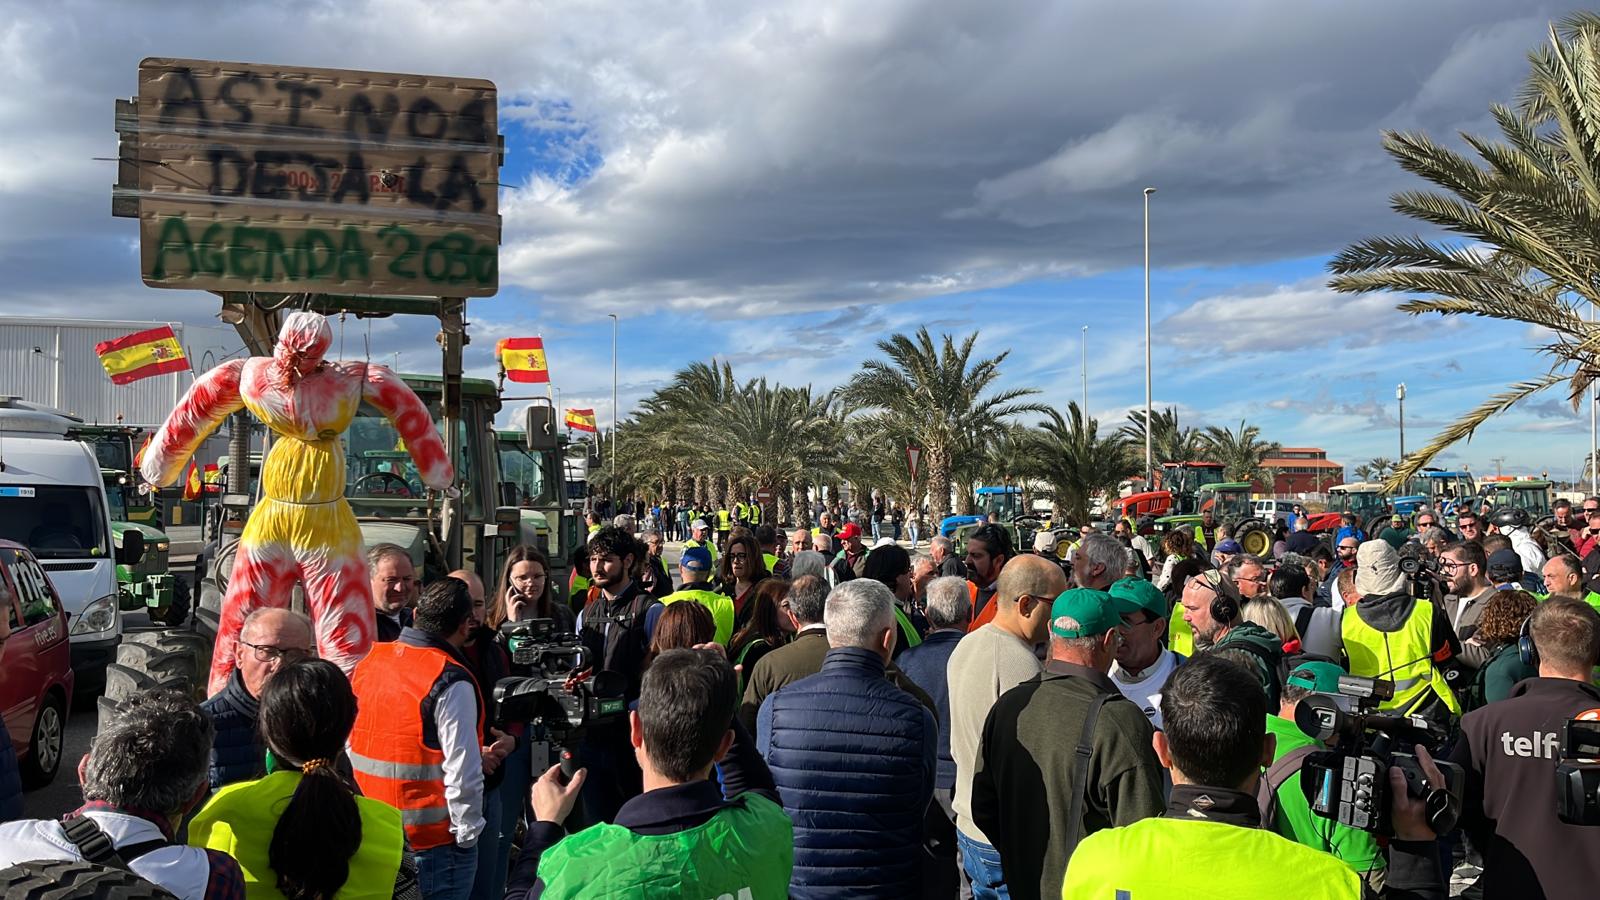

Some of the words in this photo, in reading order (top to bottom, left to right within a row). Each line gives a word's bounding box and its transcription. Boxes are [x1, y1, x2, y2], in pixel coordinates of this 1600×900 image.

[206, 145, 369, 206] DEJA
[407, 154, 486, 212] LA
[152, 217, 370, 283] AGENDA
[377, 225, 497, 285] 2030
[1501, 730, 1560, 759] telf
